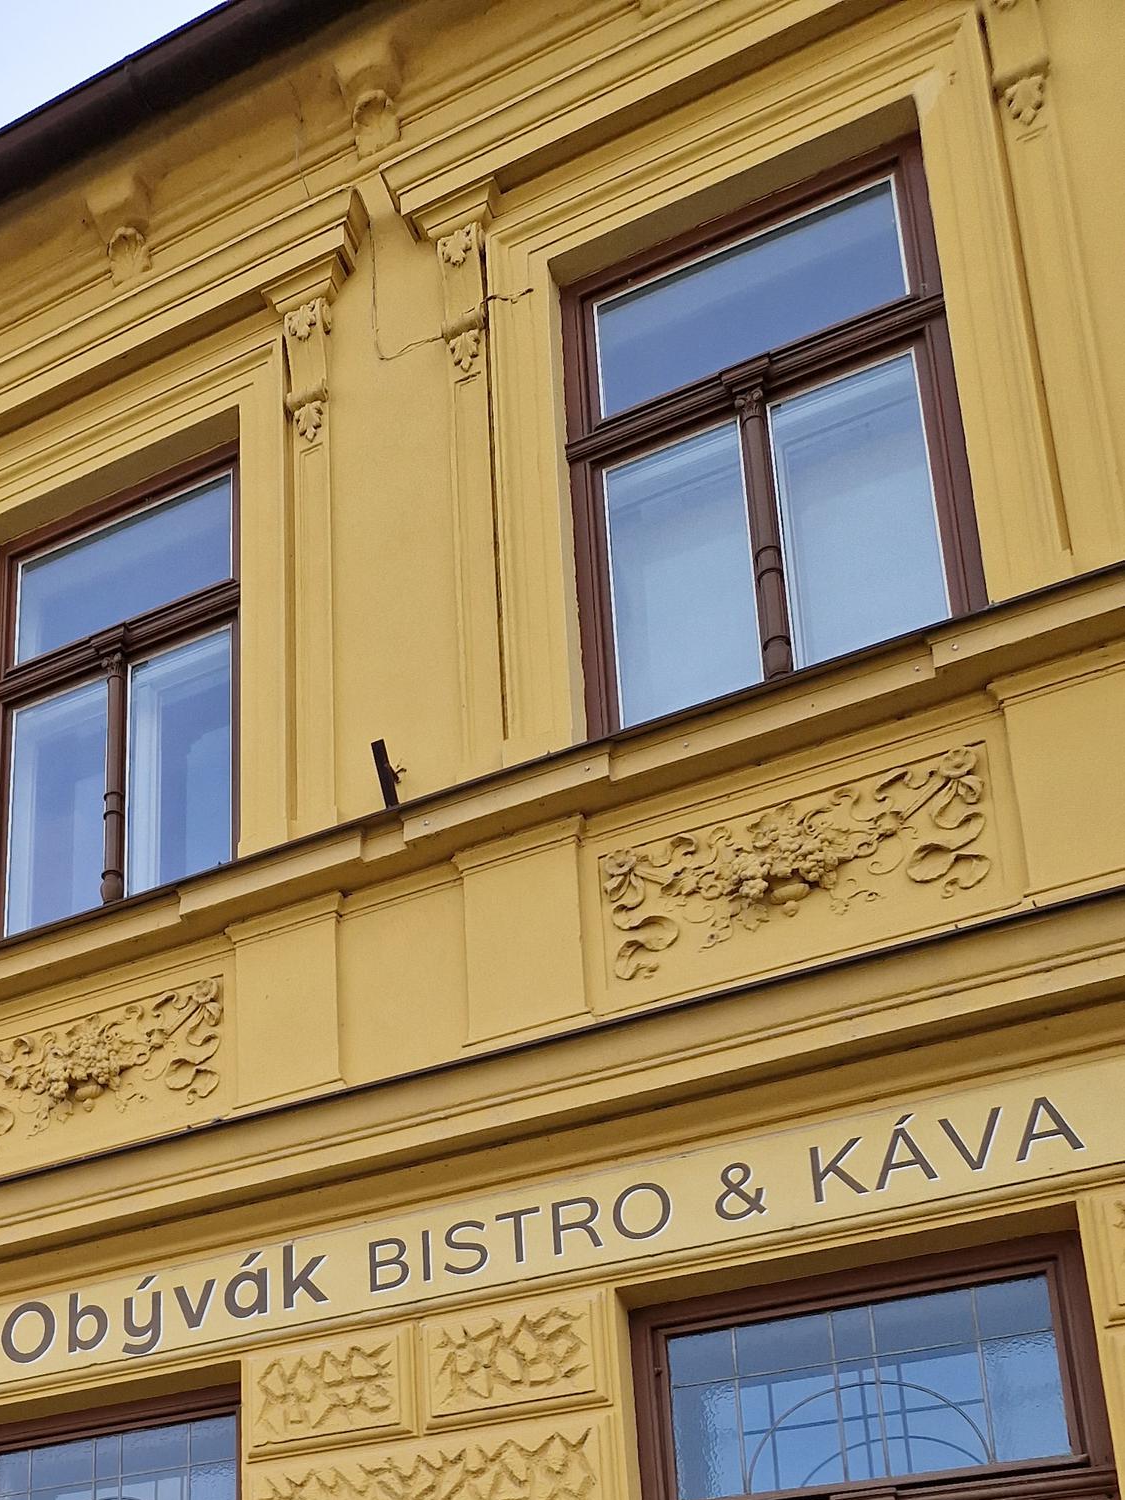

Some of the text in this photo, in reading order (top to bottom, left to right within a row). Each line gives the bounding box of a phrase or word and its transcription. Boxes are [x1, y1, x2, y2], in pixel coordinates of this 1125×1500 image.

[1, 1096, 1085, 1364] Obývák BISTRO & KÁVA
